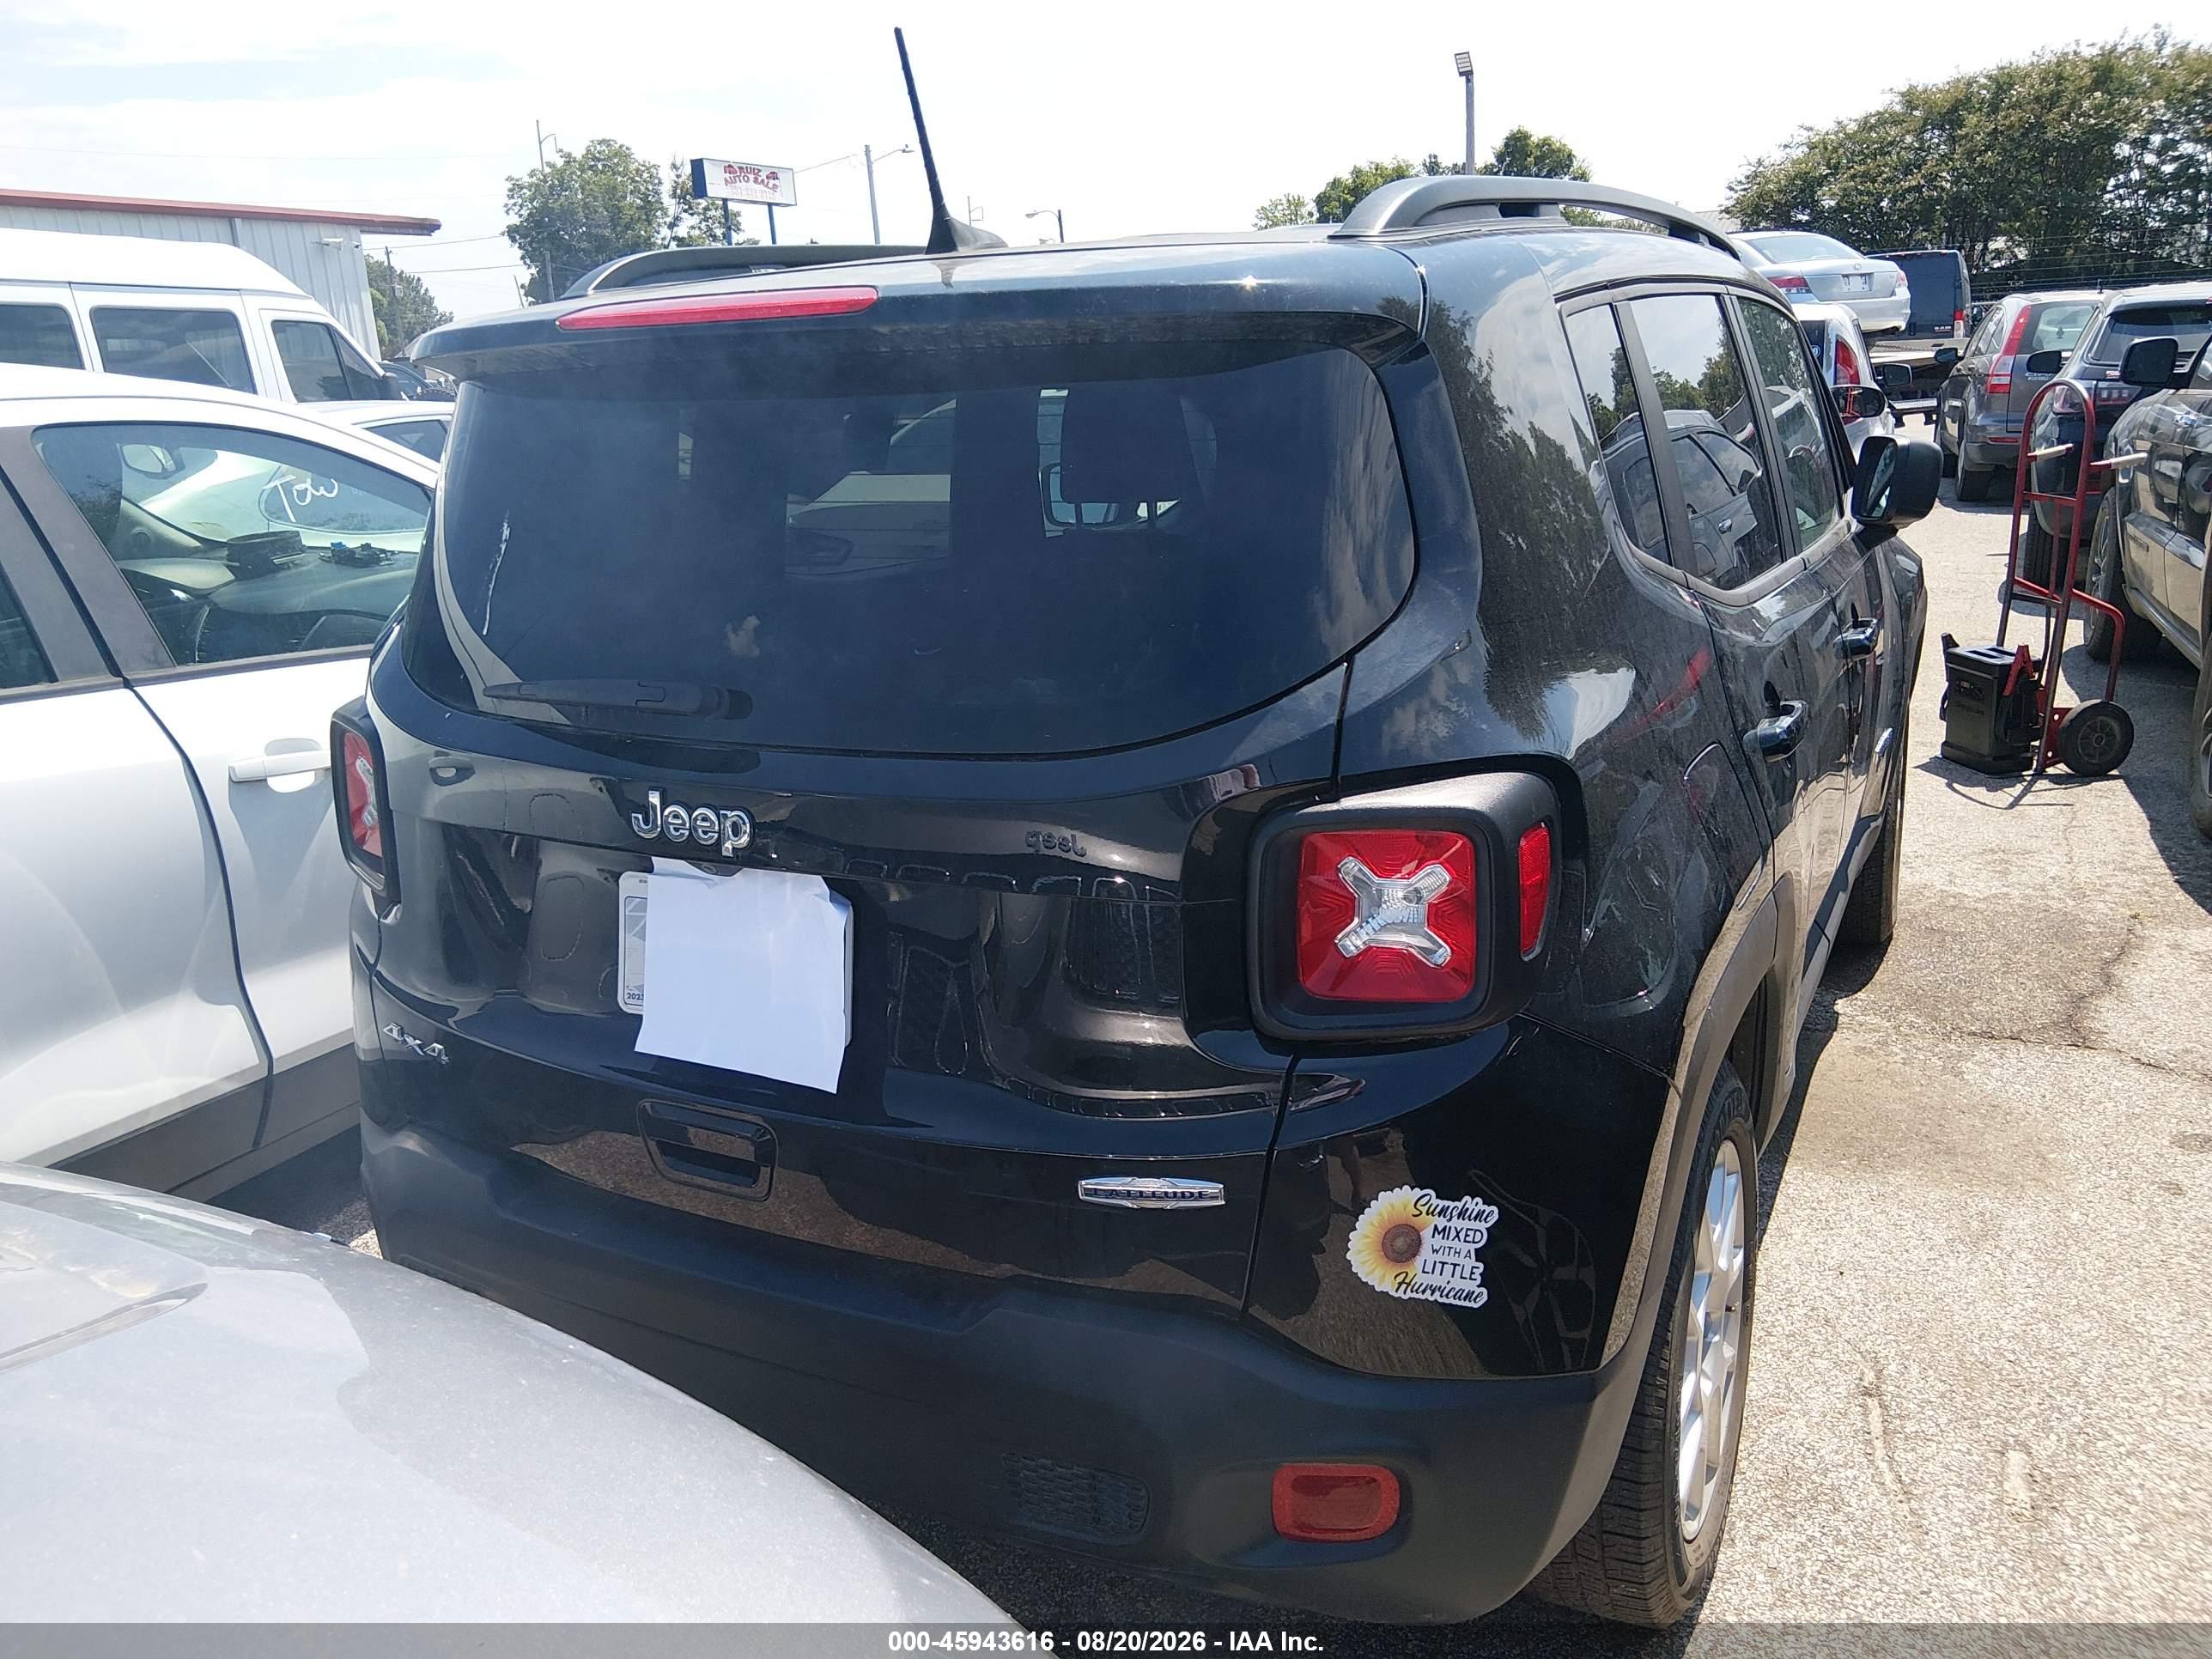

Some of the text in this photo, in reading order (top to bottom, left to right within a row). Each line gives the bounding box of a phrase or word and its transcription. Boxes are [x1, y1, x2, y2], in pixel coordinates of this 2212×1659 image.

[724, 174, 750, 186] AUTO
[631, 787, 757, 858] Jeep
[1411, 1193, 1496, 1224] Sunshine
[1431, 1224, 1484, 1244] MIXED
[1431, 1243, 1472, 1260] WITH A
[1421, 1259, 1480, 1281] LITTLE
[1394, 1270, 1485, 1304] Hurricane
